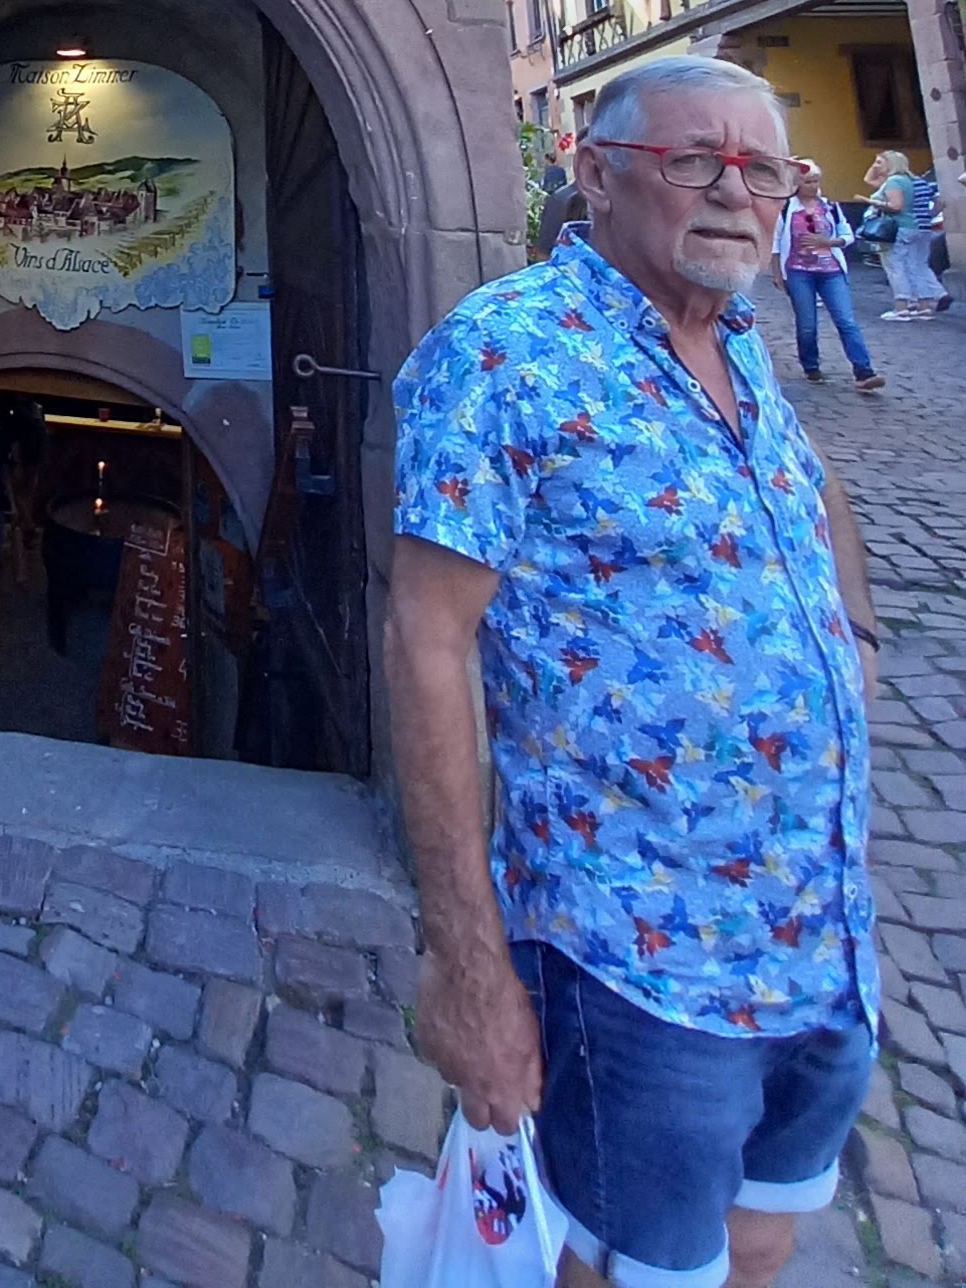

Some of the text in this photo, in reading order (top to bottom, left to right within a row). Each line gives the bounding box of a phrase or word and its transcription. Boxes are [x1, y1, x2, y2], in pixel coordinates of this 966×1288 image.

[8, 62, 139, 85] Maison Zimmer
[10, 242, 44, 269] Vins
